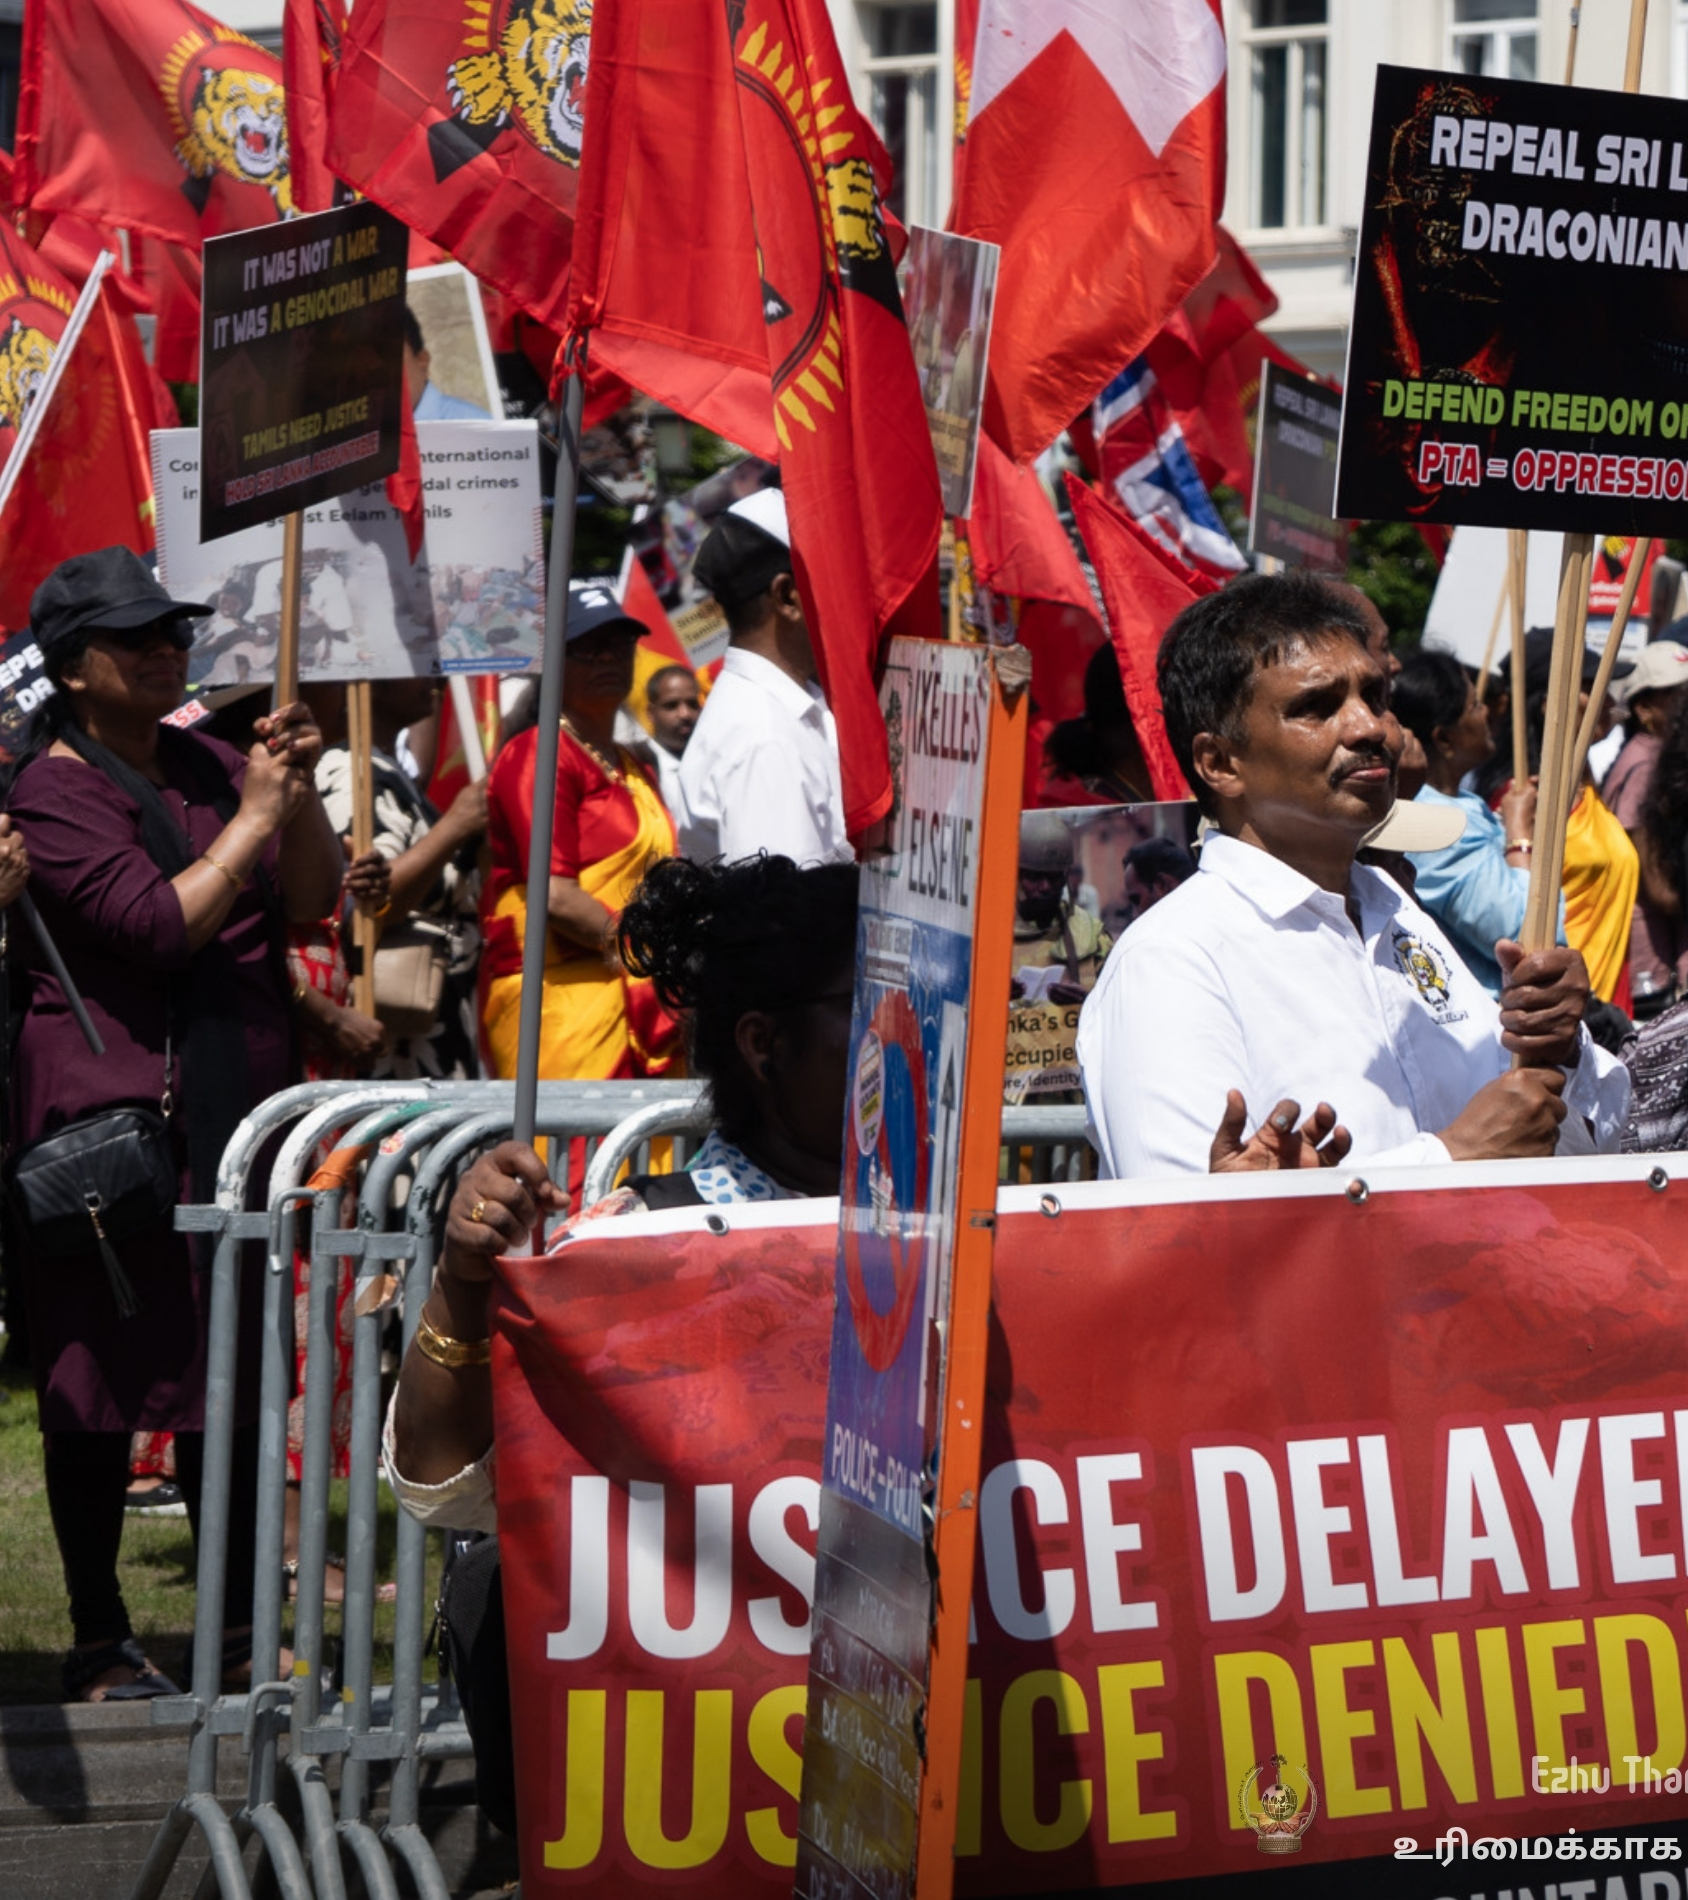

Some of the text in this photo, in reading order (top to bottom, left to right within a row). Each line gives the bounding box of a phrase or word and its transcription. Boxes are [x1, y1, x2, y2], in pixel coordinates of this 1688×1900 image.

[1431, 116, 1584, 181] REPEAL
[1595, 135, 1661, 189] SRI
[243, 226, 379, 291] IT WAS NOT A WAR
[213, 267, 399, 350] IT WAS A GENOCIDAL WAR
[243, 395, 369, 460] TAMILS NEED JUSTICE
[1383, 380, 1504, 426] DEFEND
[1512, 392, 1653, 437] FREEDOM
[457, 476, 519, 490] crimes
[1419, 442, 1480, 486] PTA
[329, 508, 386, 522] Eelam
[912, 667, 988, 765] IXELLES
[908, 807, 973, 907] ELSENE
[546, 1452, 1159, 1660] JUSCE
[544, 1660, 1177, 1869] JUSICE
